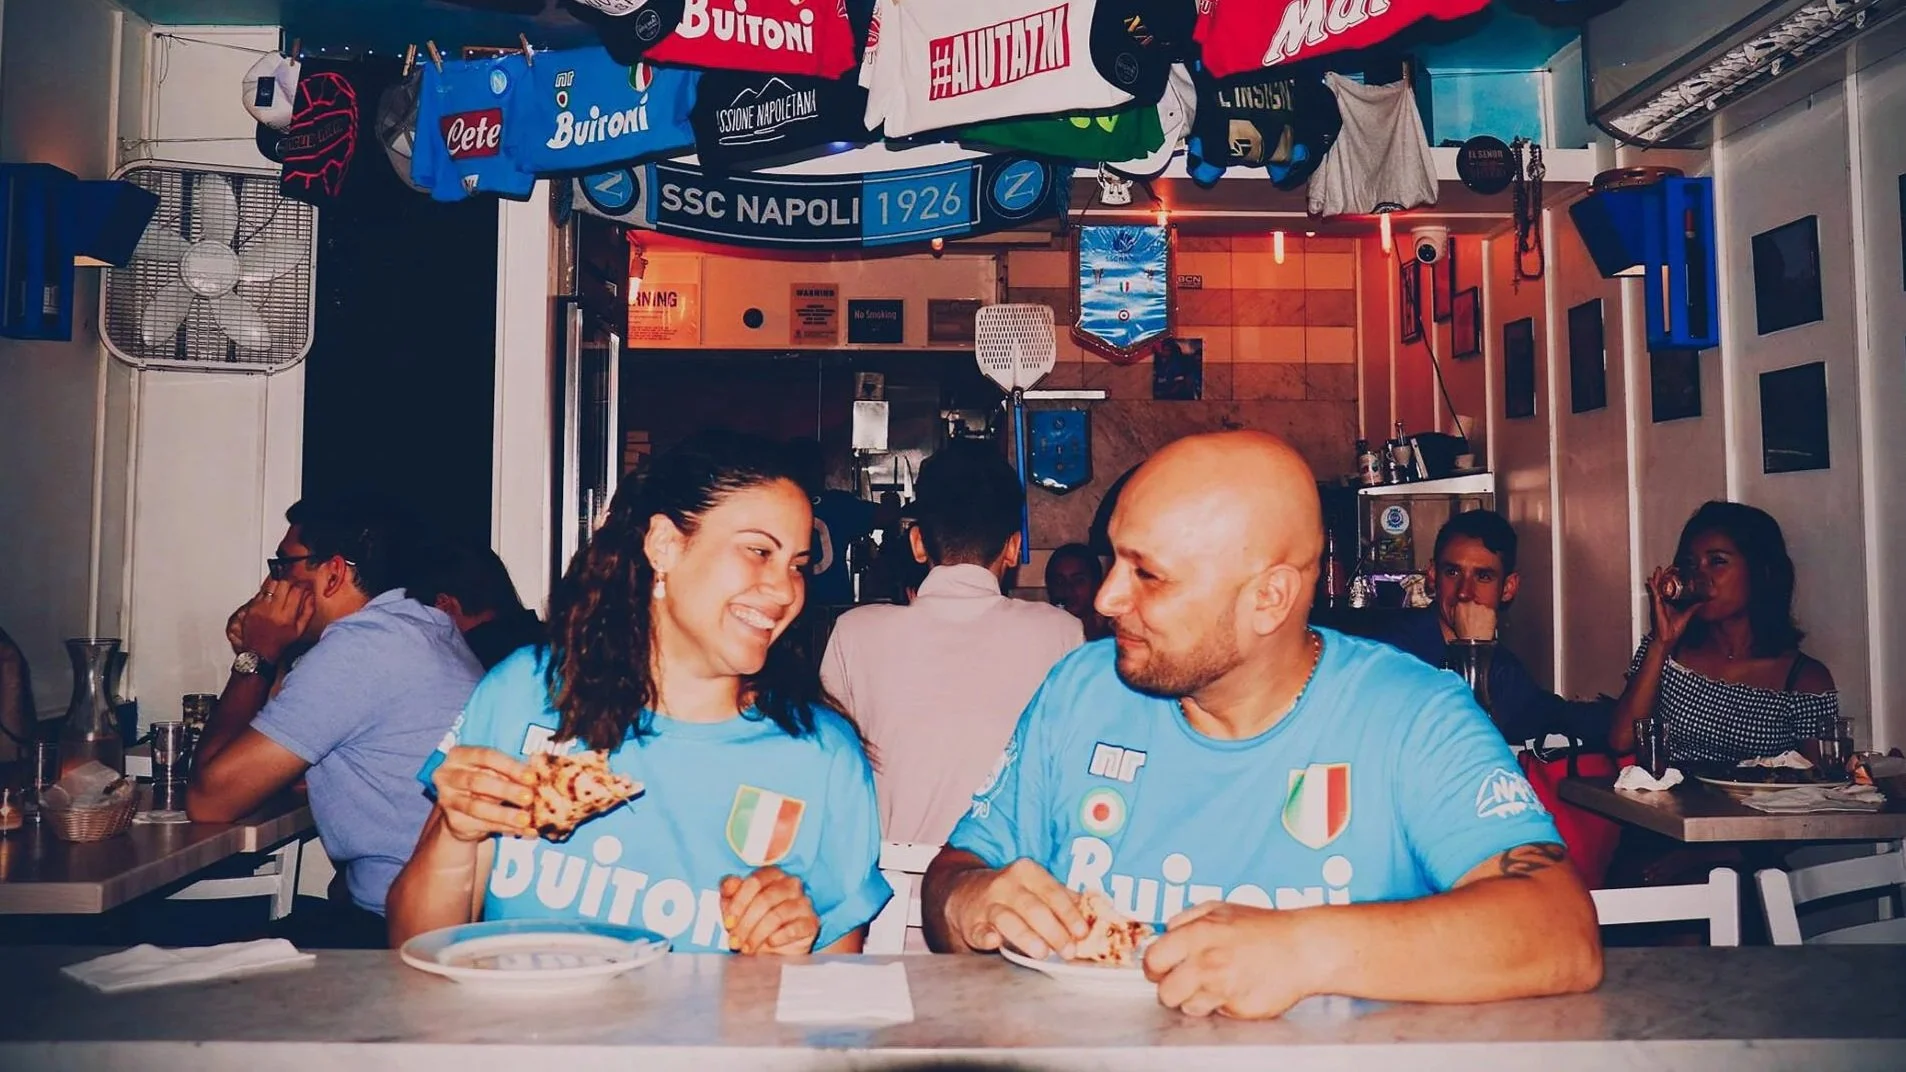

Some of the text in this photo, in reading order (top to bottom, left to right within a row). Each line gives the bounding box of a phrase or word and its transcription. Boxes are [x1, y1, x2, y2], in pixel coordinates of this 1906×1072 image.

[546, 93, 650, 149] Buitoni
[661, 183, 726, 219] SSC
[737, 194, 859, 226] NAPOLI
[878, 182, 961, 225] 1926
[854, 310, 897, 320] No Smoking
[489, 834, 733, 951] Buiton
